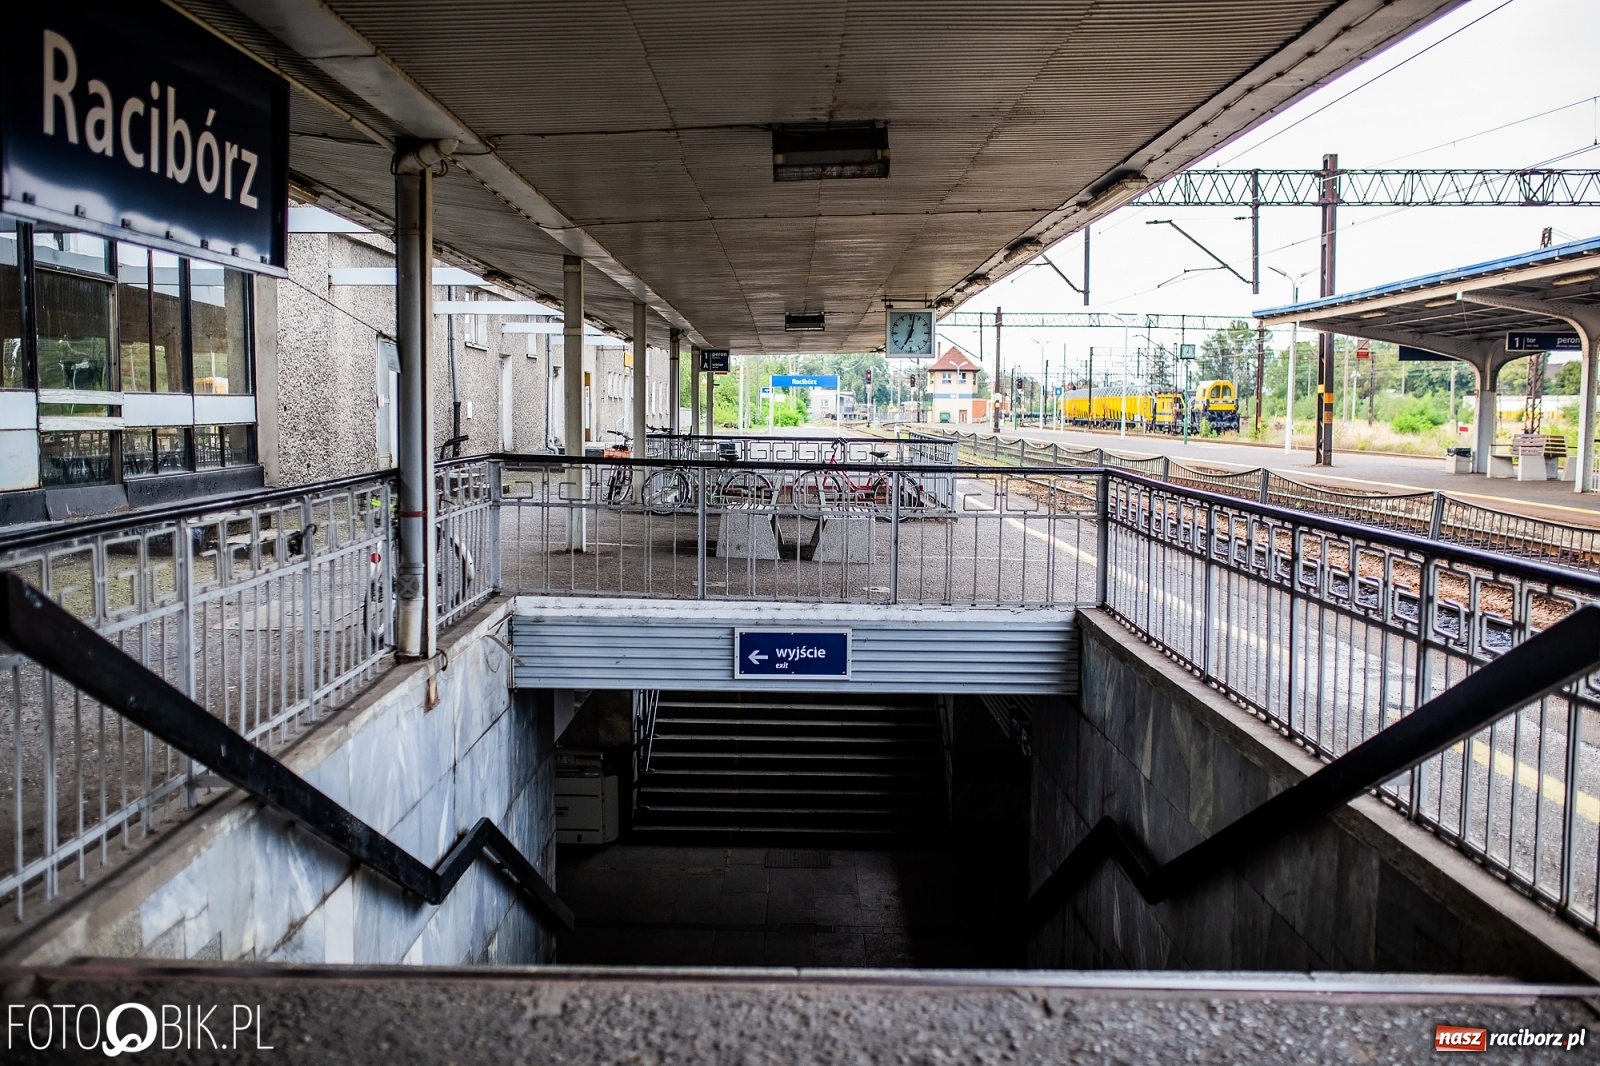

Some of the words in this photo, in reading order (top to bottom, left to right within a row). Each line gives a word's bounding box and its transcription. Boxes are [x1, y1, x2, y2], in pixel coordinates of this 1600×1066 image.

[43, 29, 258, 210] Racibórz
[1514, 337, 1520, 348] 1
[1557, 337, 1580, 345] peron
[775, 645, 826, 661] wyjście
